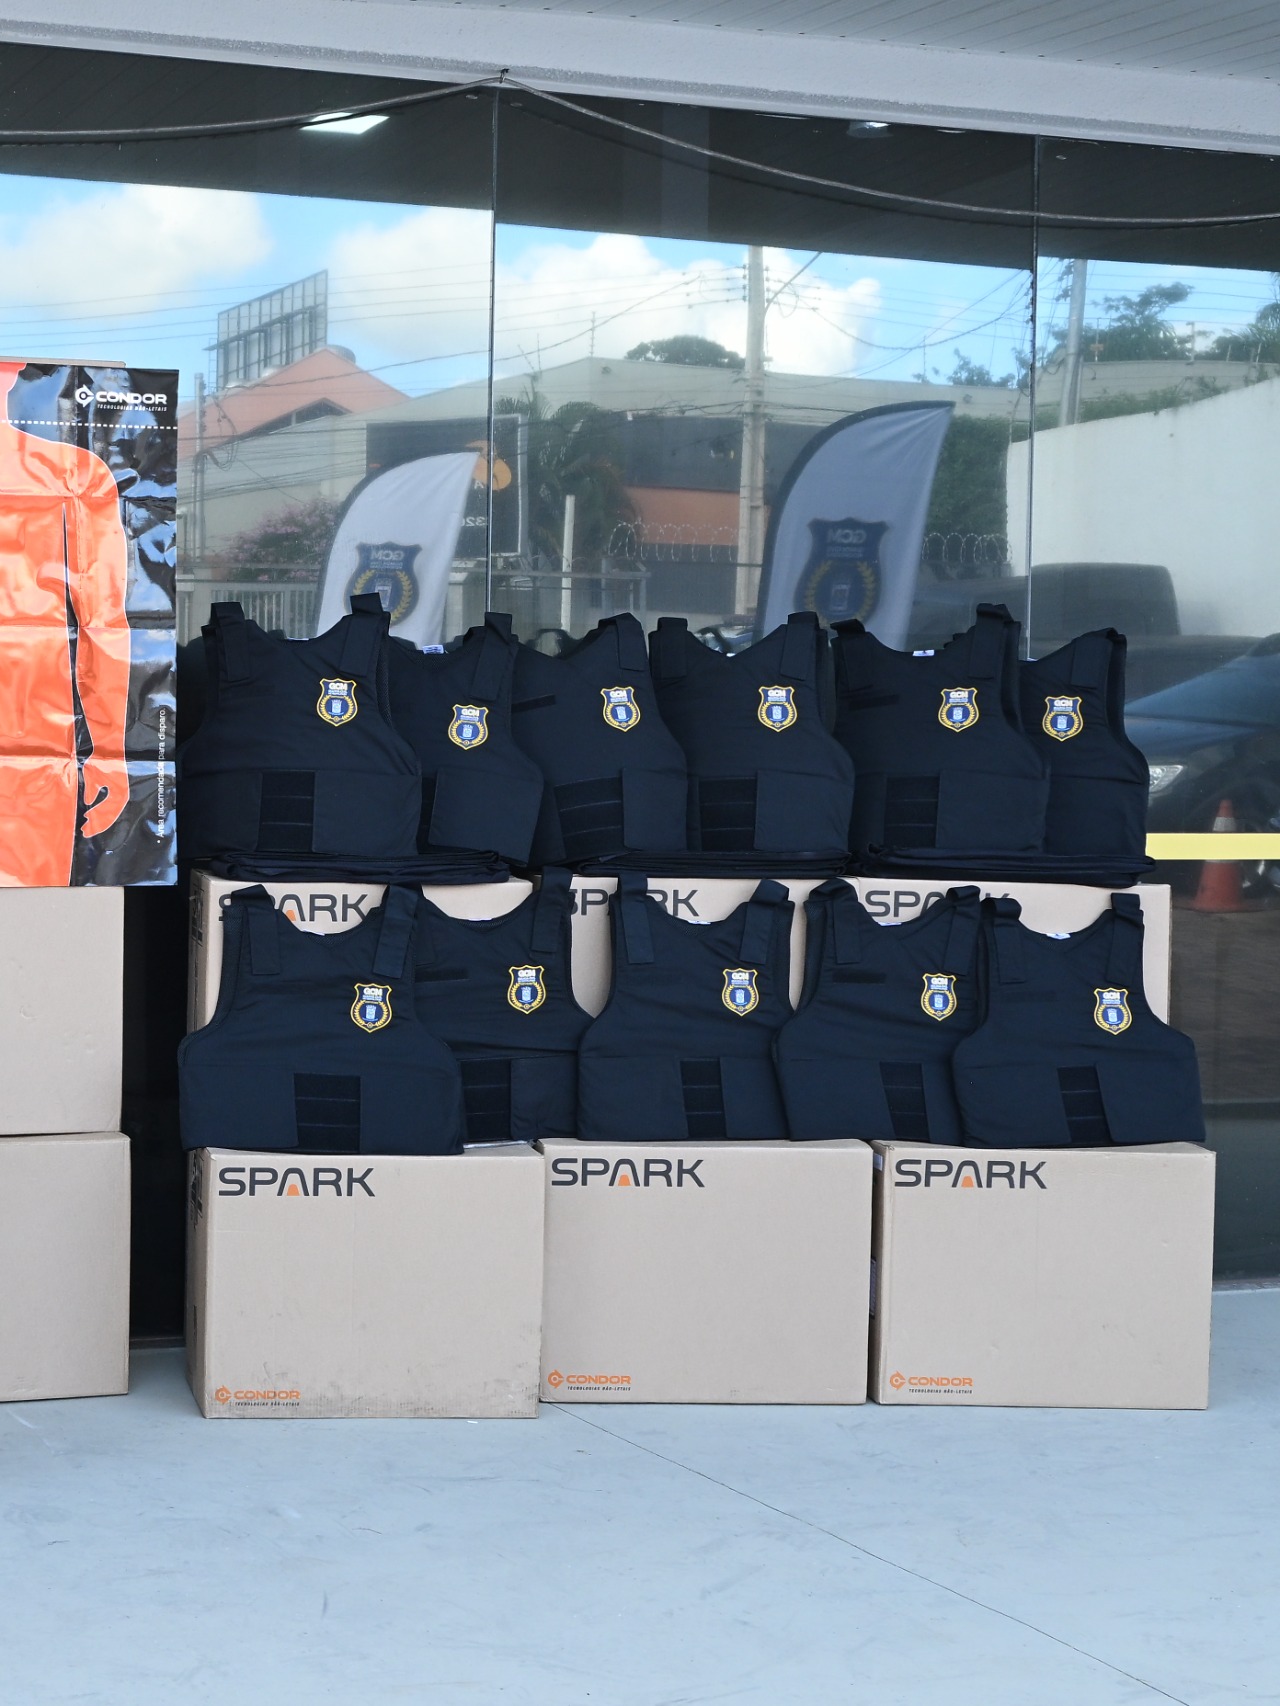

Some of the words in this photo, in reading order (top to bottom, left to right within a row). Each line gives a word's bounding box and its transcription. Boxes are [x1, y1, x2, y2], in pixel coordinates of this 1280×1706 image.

[95, 391, 168, 405] CONDOR
[158, 743, 166, 760] para
[157, 762, 165, 818] recomendada
[552, 1158, 705, 1187] SPARK
[895, 1159, 1047, 1189] SPARK
[219, 1168, 375, 1198] SPARK
[566, 1375, 631, 1385] CONDOR
[908, 1377, 973, 1387] CONDOR
[233, 1390, 300, 1400] CONDOR
